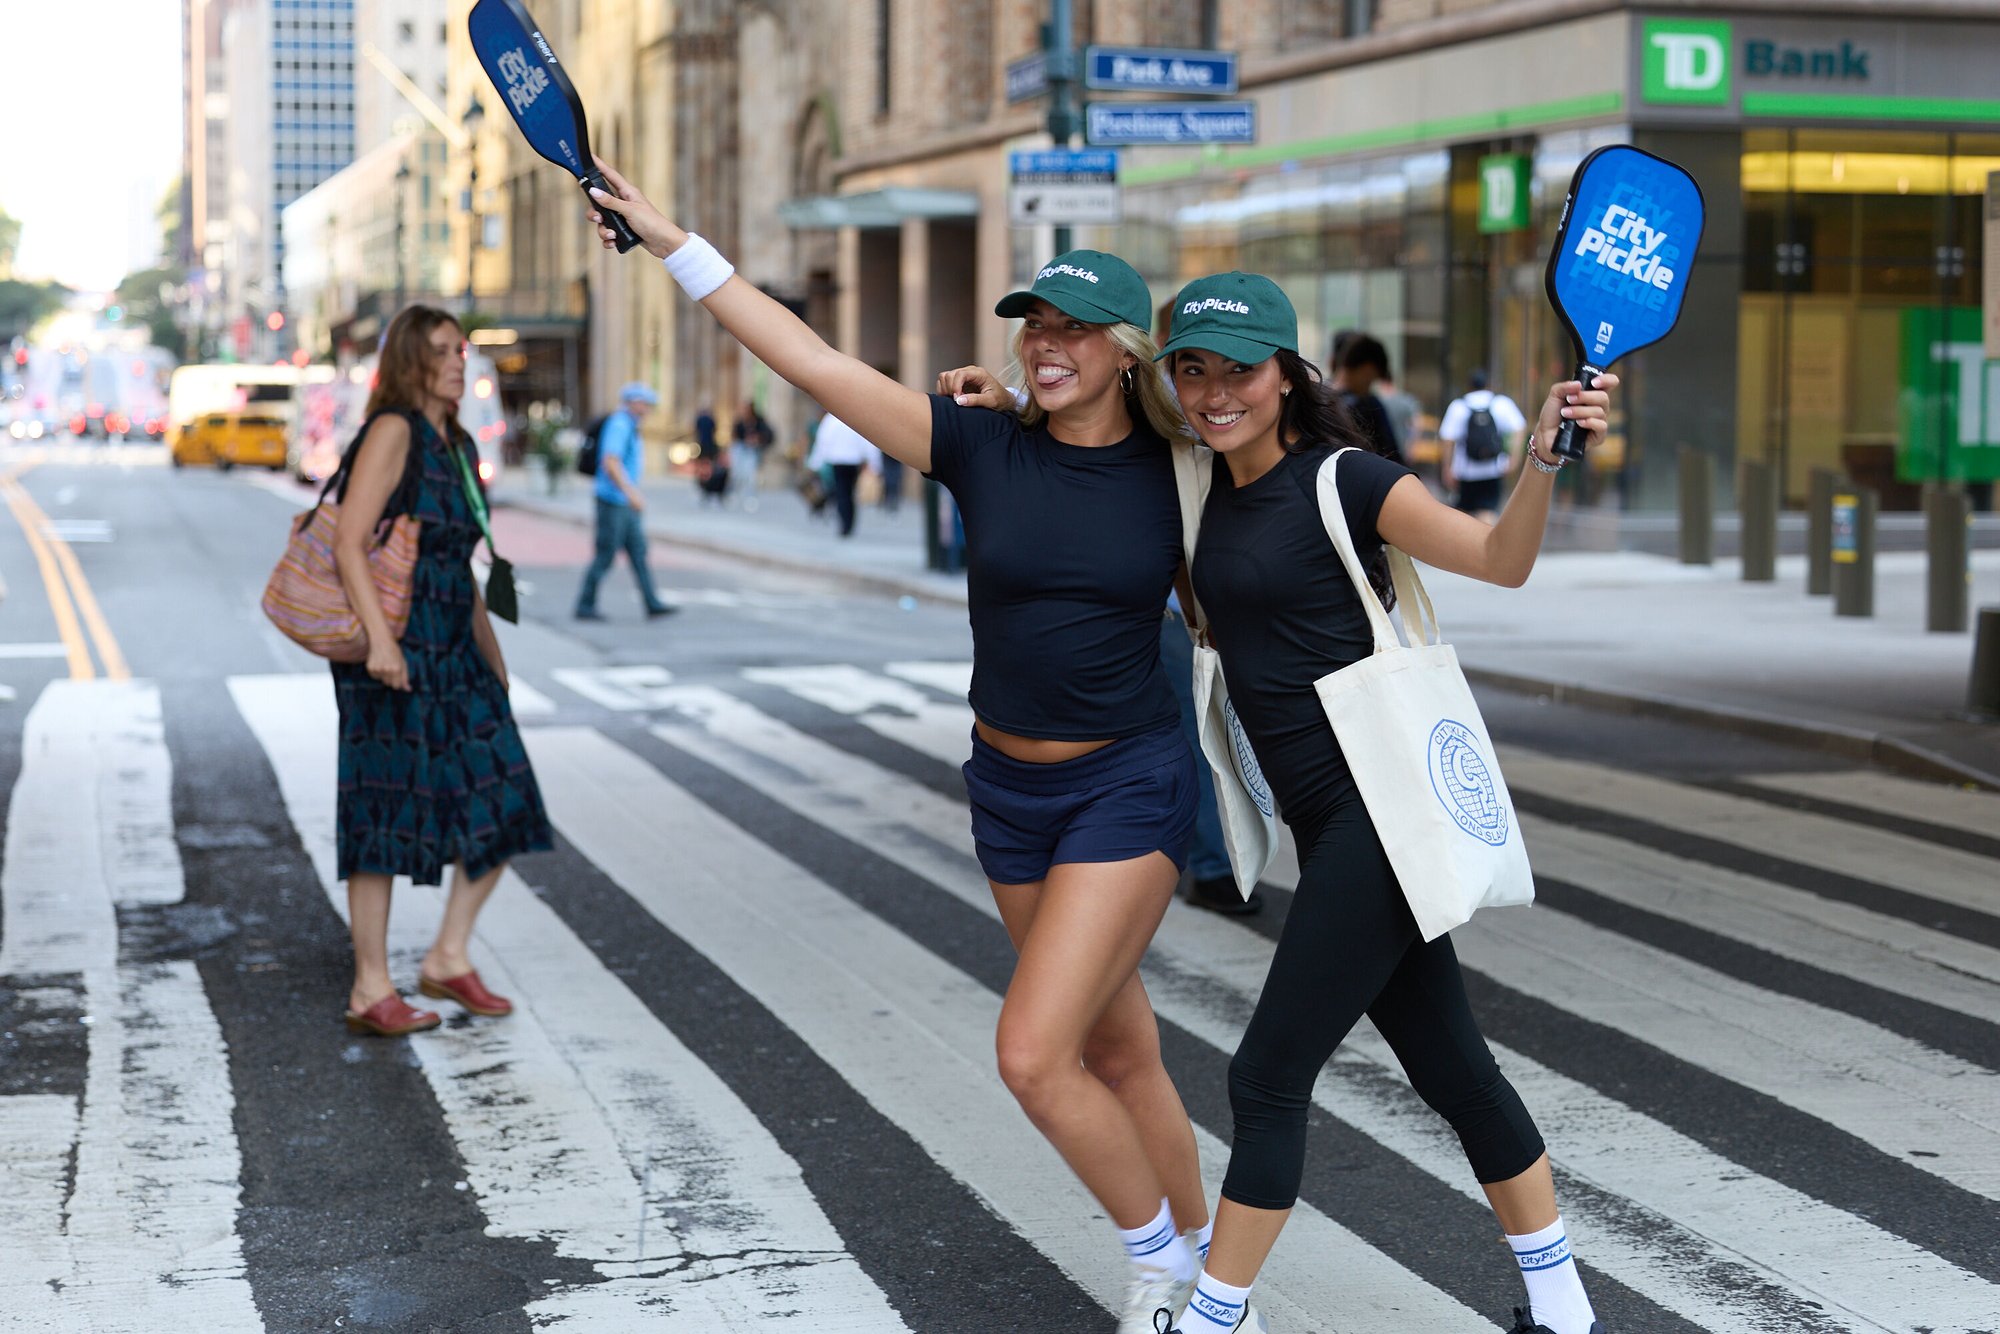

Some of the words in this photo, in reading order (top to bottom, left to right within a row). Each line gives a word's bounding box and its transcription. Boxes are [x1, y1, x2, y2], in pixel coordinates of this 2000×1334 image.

[497, 47, 528, 85] City
[1112, 55, 1164, 83] Park
[1166, 58, 1214, 86] Ave
[1650, 32, 1724, 90] TD
[1744, 40, 1870, 80] Bank
[507, 65, 549, 116] Pickle
[1601, 203, 1667, 257] City
[1037, 264, 1099, 284] CityPickle
[1575, 227, 1674, 291] Pickle
[1182, 298, 1250, 315] CityPickle
[1455, 809, 1482, 836] LONG
